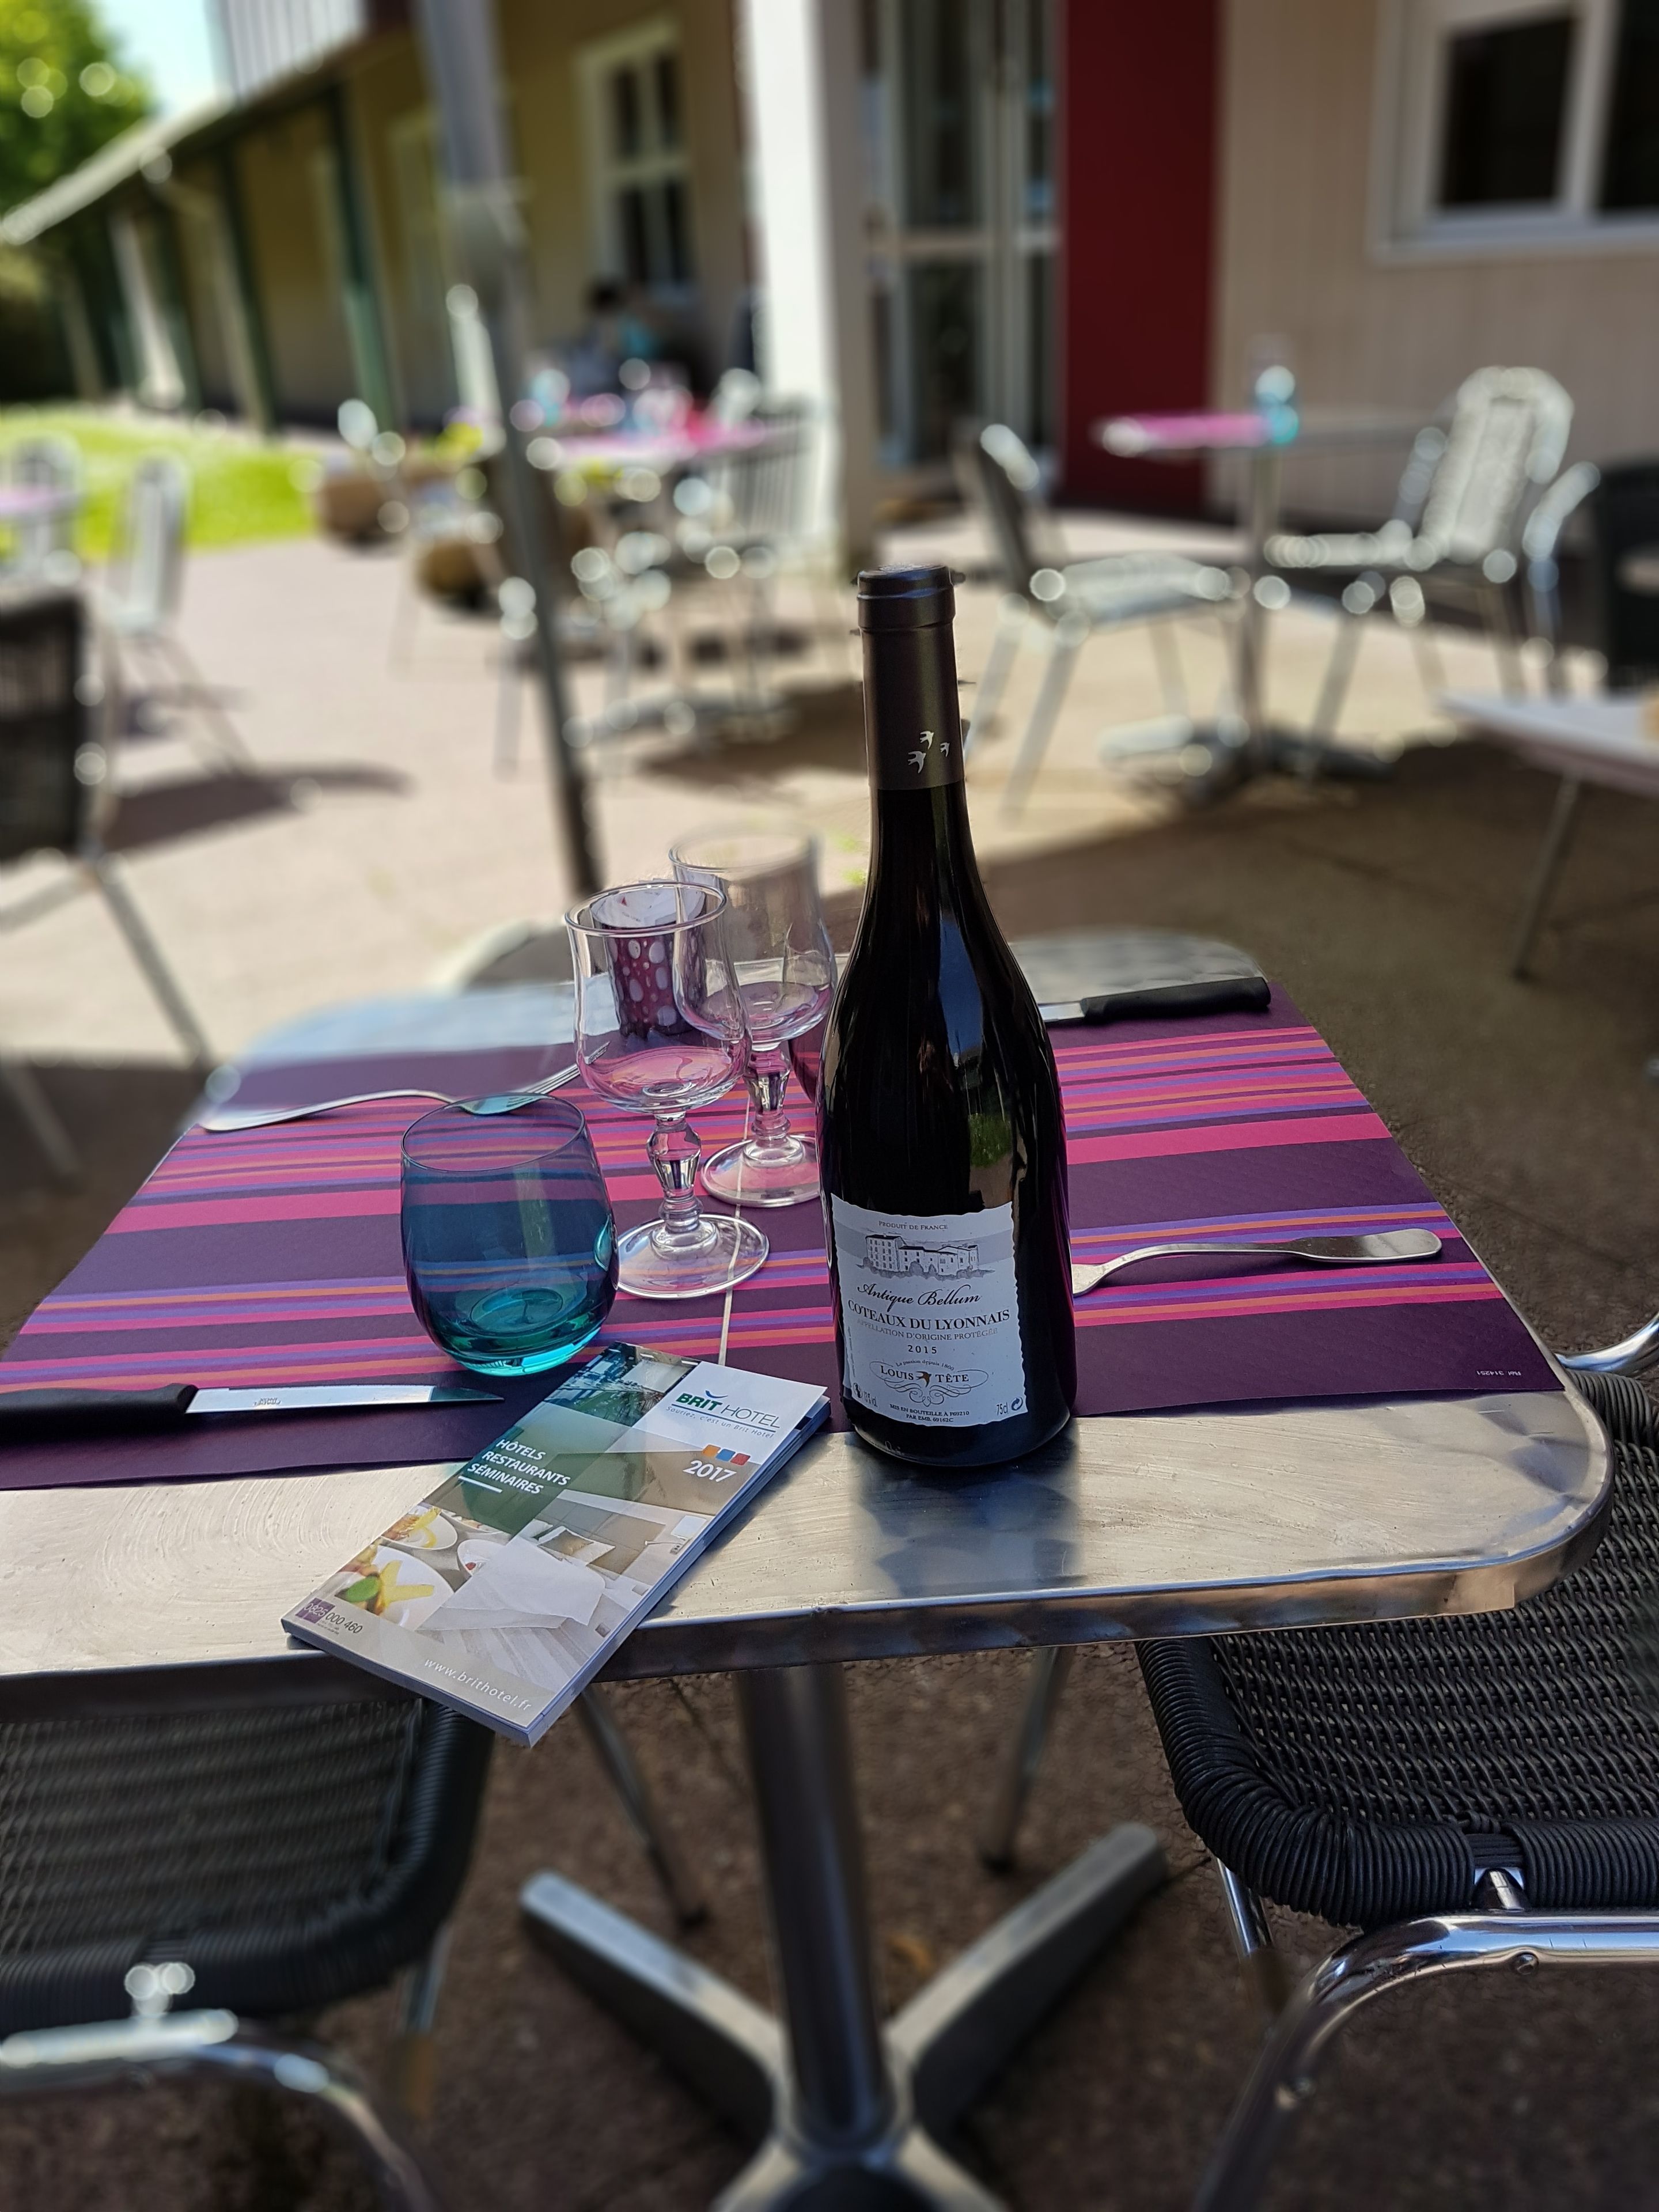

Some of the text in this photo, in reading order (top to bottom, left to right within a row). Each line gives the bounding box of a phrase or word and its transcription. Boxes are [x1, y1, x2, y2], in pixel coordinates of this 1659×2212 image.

[878, 1221, 907, 1229] PRODUIT
[857, 1283, 982, 1312] Antique Bellum
[848, 1300, 1010, 1330] COTEAUX DU LYONNAIS
[857, 1319, 904, 1338] APPELLATION
[906, 1332, 952, 1340] D'ORIGINE
[907, 1345, 937, 1354] 2015
[880, 1365, 969, 1382] LOUIS TÊTE
[666, 1406, 696, 1419] Souriez,
[700, 1416, 719, 1425] c'est
[733, 1425, 749, 1433] Brit
[751, 1429, 774, 1438] Hotel
[676, 1393, 780, 1428] BRIT HOTEL
[495, 1439, 546, 1460] HÔTELS
[467, 1463, 544, 1494] SÉMINAIRES
[482, 1451, 571, 1486] RESTAURANTS
[683, 1460, 737, 1482] 2017
[304, 1603, 328, 1617] 0825
[325, 1612, 345, 1624] 000
[344, 1621, 363, 1633] 460
[424, 1659, 532, 1710] www.brithotel.fr
